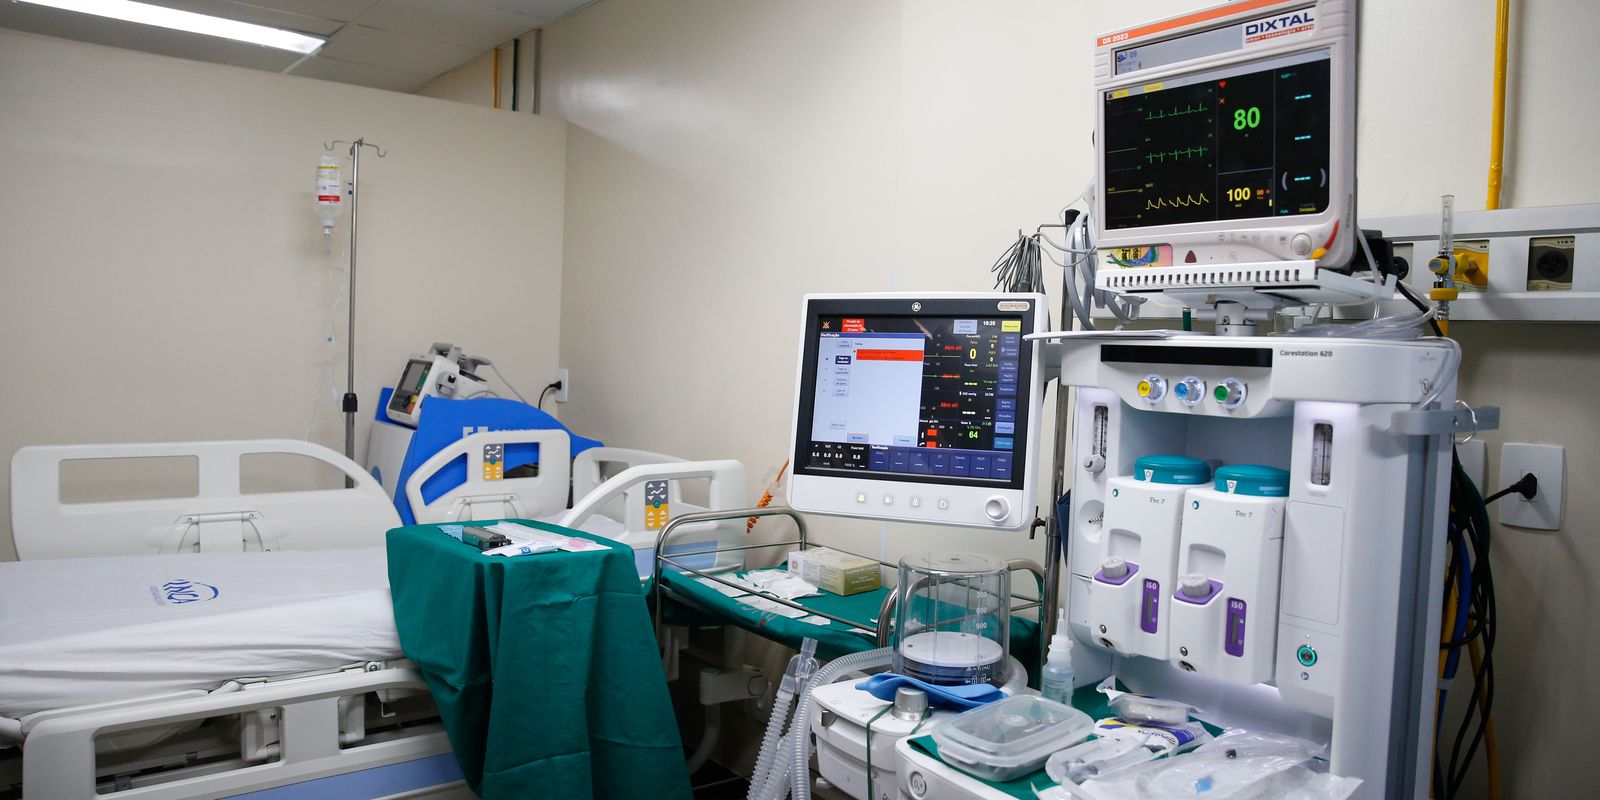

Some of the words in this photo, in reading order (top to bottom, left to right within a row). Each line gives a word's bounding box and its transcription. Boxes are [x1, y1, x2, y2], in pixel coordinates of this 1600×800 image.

[1245, 12, 1315, 36] DIXTAL
[1102, 36, 1112, 45] DX
[1112, 33, 1129, 42] 2023
[1233, 107, 1261, 130] 80
[1226, 187, 1251, 202] 100
[969, 348, 977, 359] 0
[1279, 349, 1319, 357] Carestation
[968, 430, 979, 439] 64
[1149, 496, 1161, 504] Tec
[1235, 510, 1247, 518] Tec
[1146, 581, 1157, 590] ISO
[1231, 600, 1244, 610] ISO
[975, 622, 987, 630] 900
